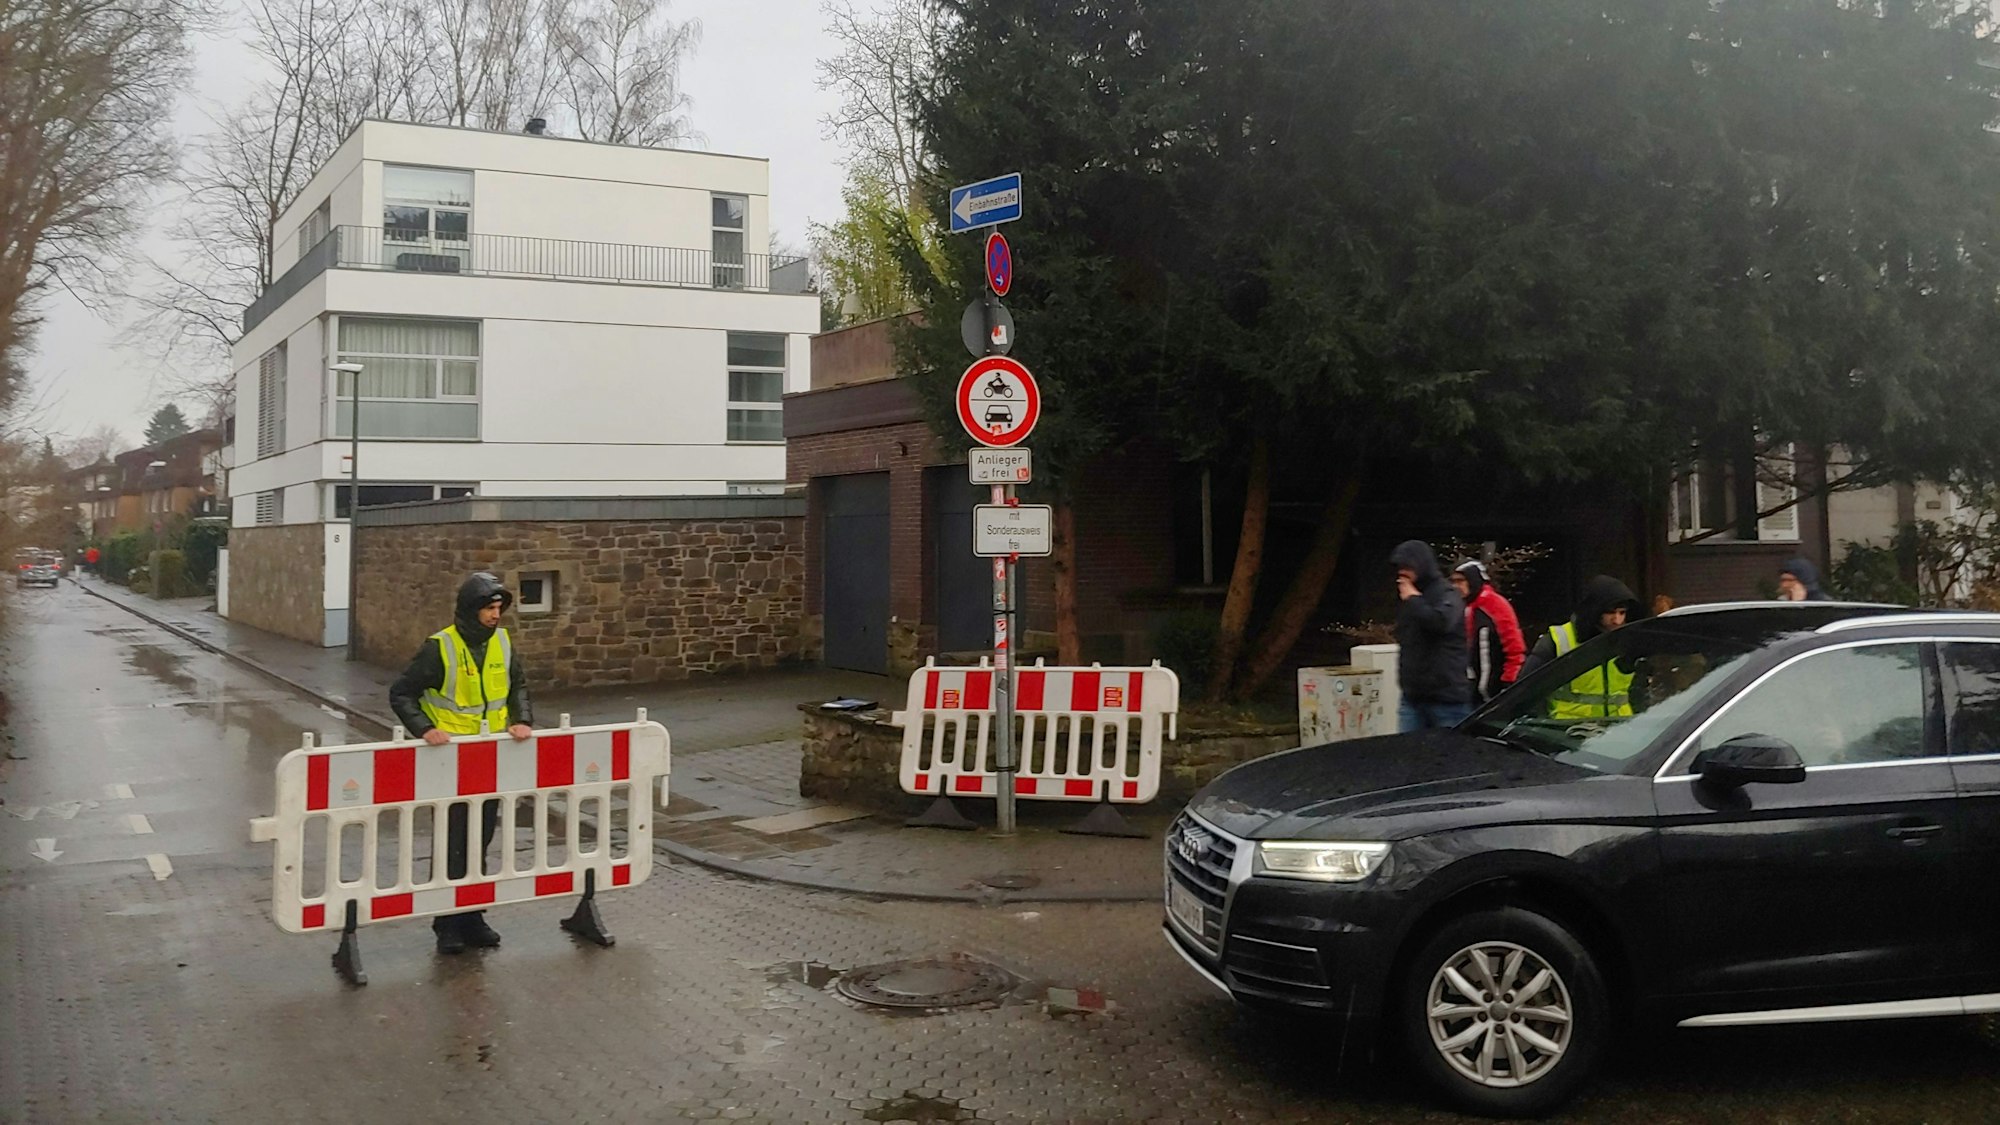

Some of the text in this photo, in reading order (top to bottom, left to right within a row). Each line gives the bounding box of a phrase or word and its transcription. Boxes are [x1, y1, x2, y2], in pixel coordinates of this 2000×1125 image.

[969, 193, 1016, 212] Einbahnstraße
[977, 455, 1023, 467] Anlieger
[992, 468, 1009, 478] frei
[1009, 511, 1020, 521] mit
[987, 525, 1041, 535] Sonderausweis
[1009, 539, 1020, 550] frei
